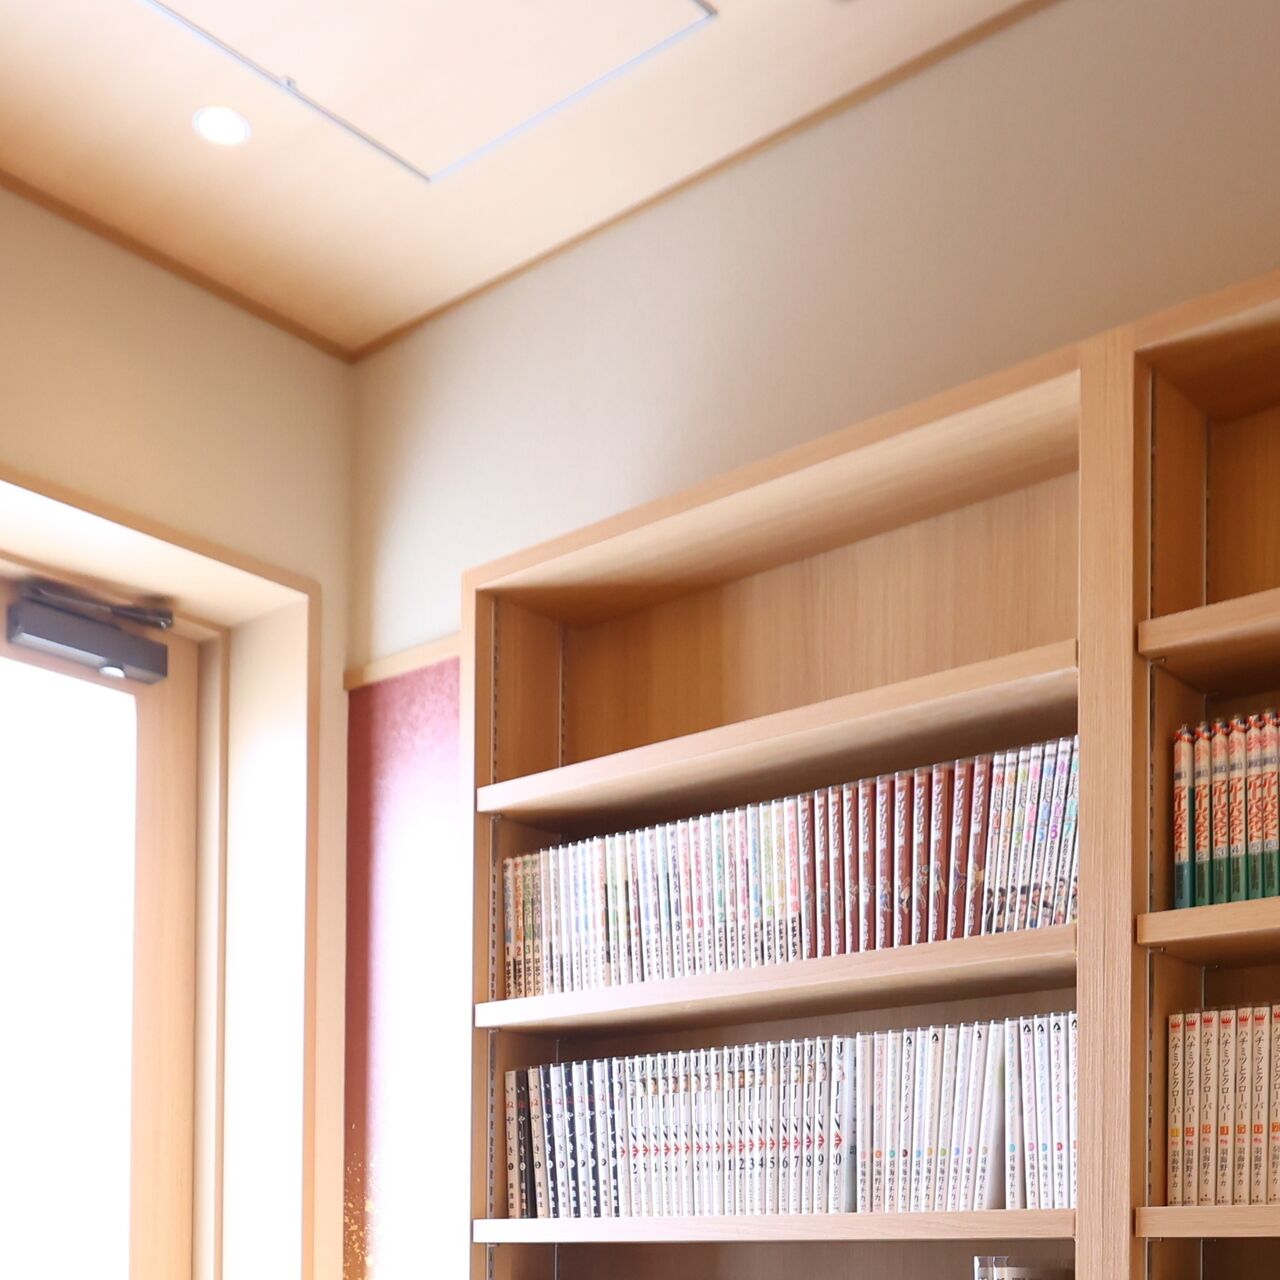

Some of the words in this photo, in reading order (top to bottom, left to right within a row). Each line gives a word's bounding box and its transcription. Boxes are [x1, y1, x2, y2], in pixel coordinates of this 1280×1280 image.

[1171, 1037, 1180, 1123] ハチミツとクローバー
[1186, 1035, 1195, 1122] ハチミツとクローバー
[1203, 1032, 1213, 1120] ハチミツとクローバー
[1222, 1033, 1231, 1120] ハチミツとクローバー
[1239, 1031, 1248, 1119] ハチミツとクローバー
[1255, 1030, 1264, 1118] ハチミツとクローバー
